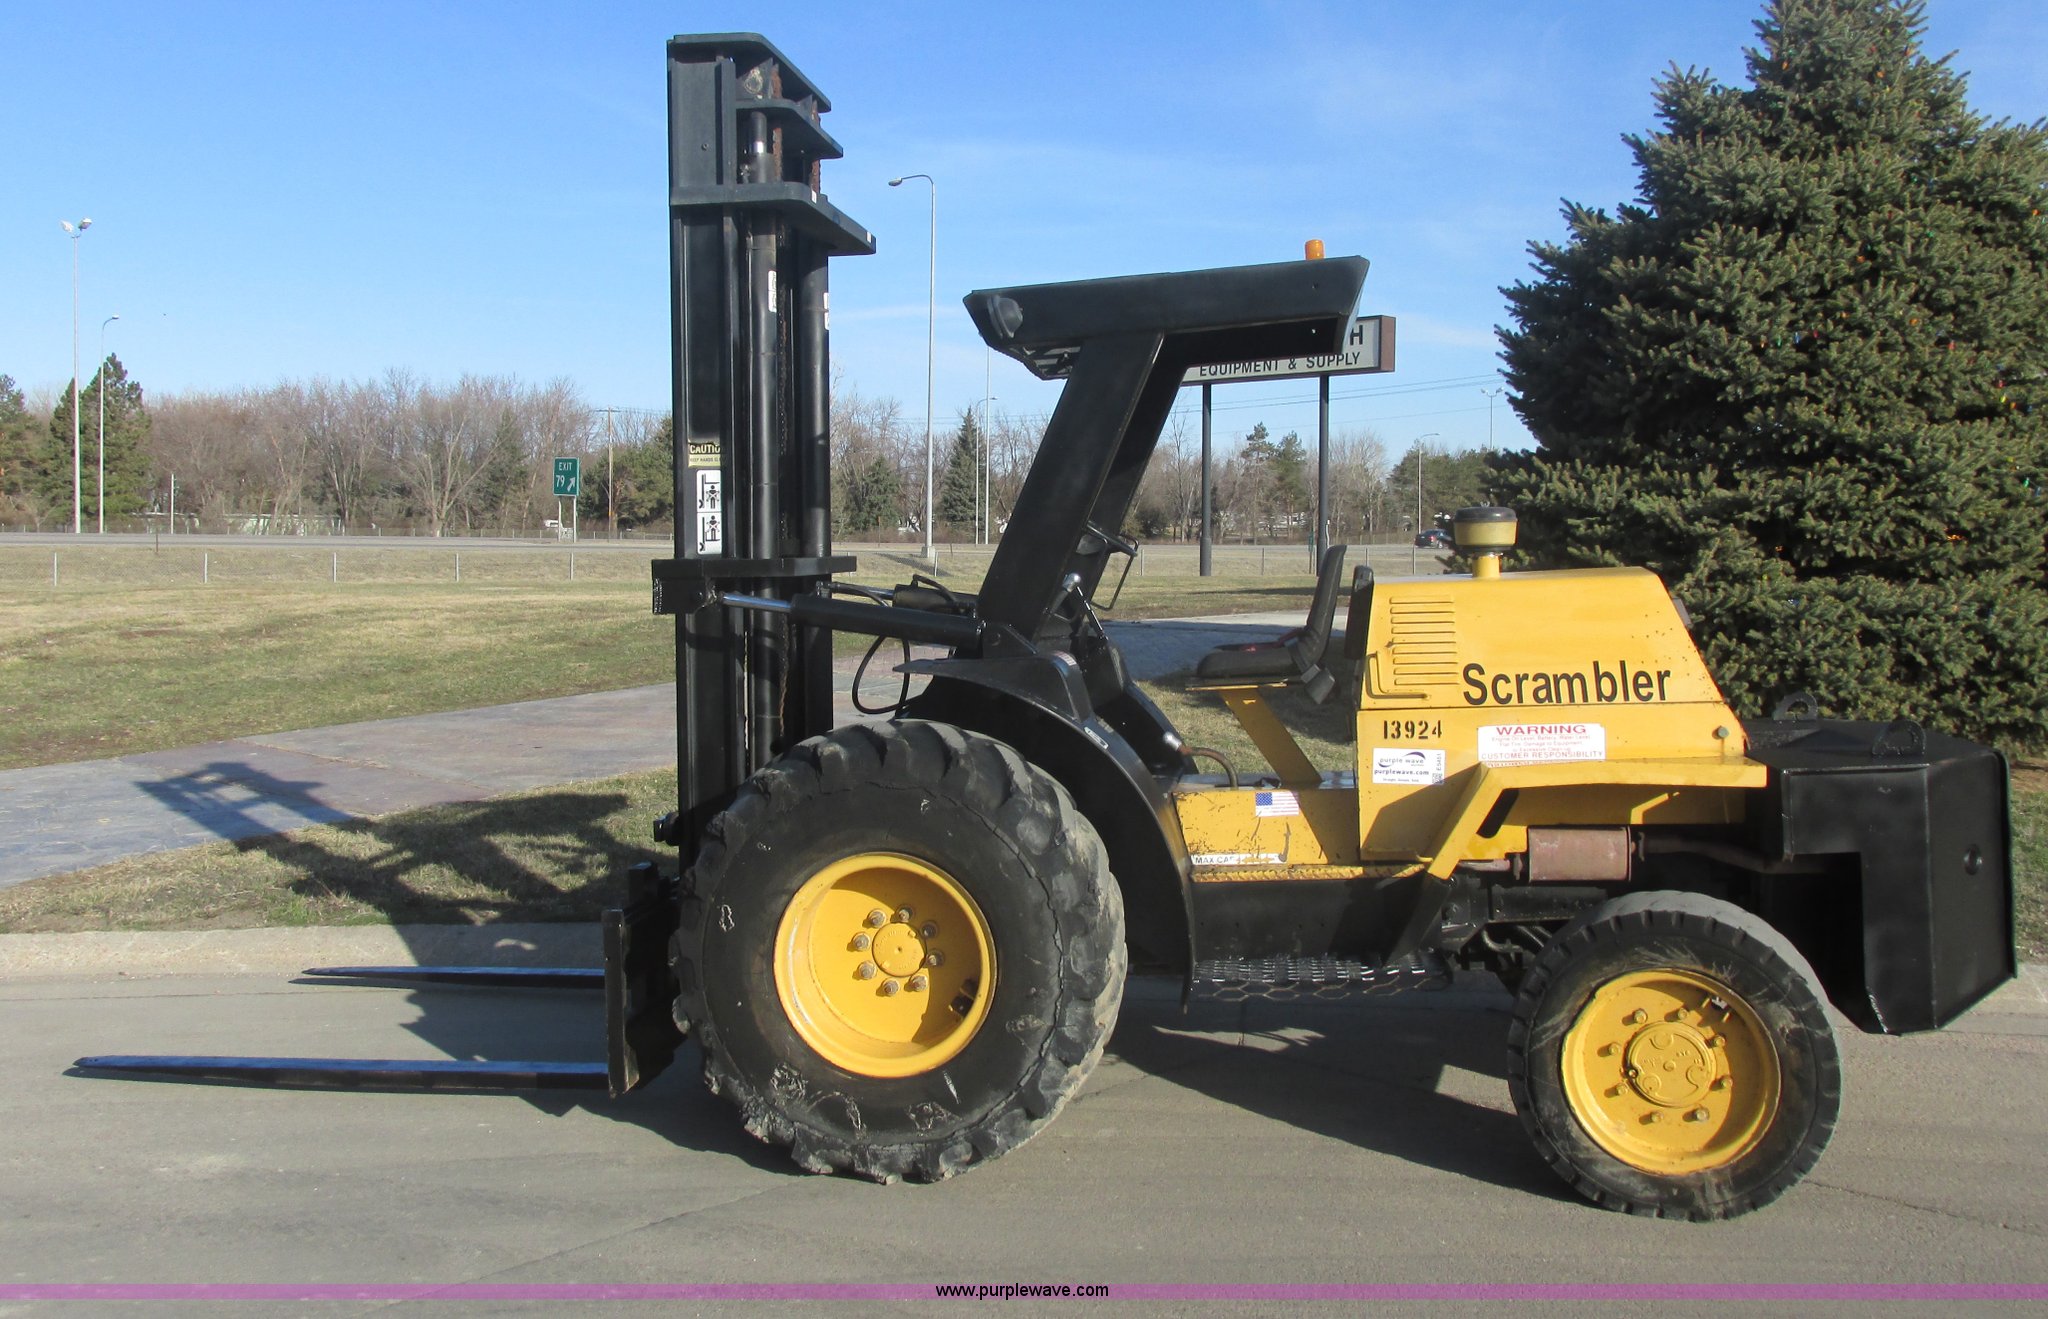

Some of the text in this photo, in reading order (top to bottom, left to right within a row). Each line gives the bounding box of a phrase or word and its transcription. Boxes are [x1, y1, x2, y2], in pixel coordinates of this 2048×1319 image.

[1200, 351, 1361, 377] EQUIPMENT & SUPPLY
[690, 444, 720, 454] CAUTIO
[558, 462, 573, 471] EXIT
[555, 474, 565, 487] 79
[1462, 660, 1671, 706] Scrambler
[1383, 720, 1442, 740] 13924
[1496, 724, 1587, 736] WARNING
[1481, 750, 1603, 760] CUSTOMER RESPONSIBILITY
[1195, 856, 1215, 864] MAX
